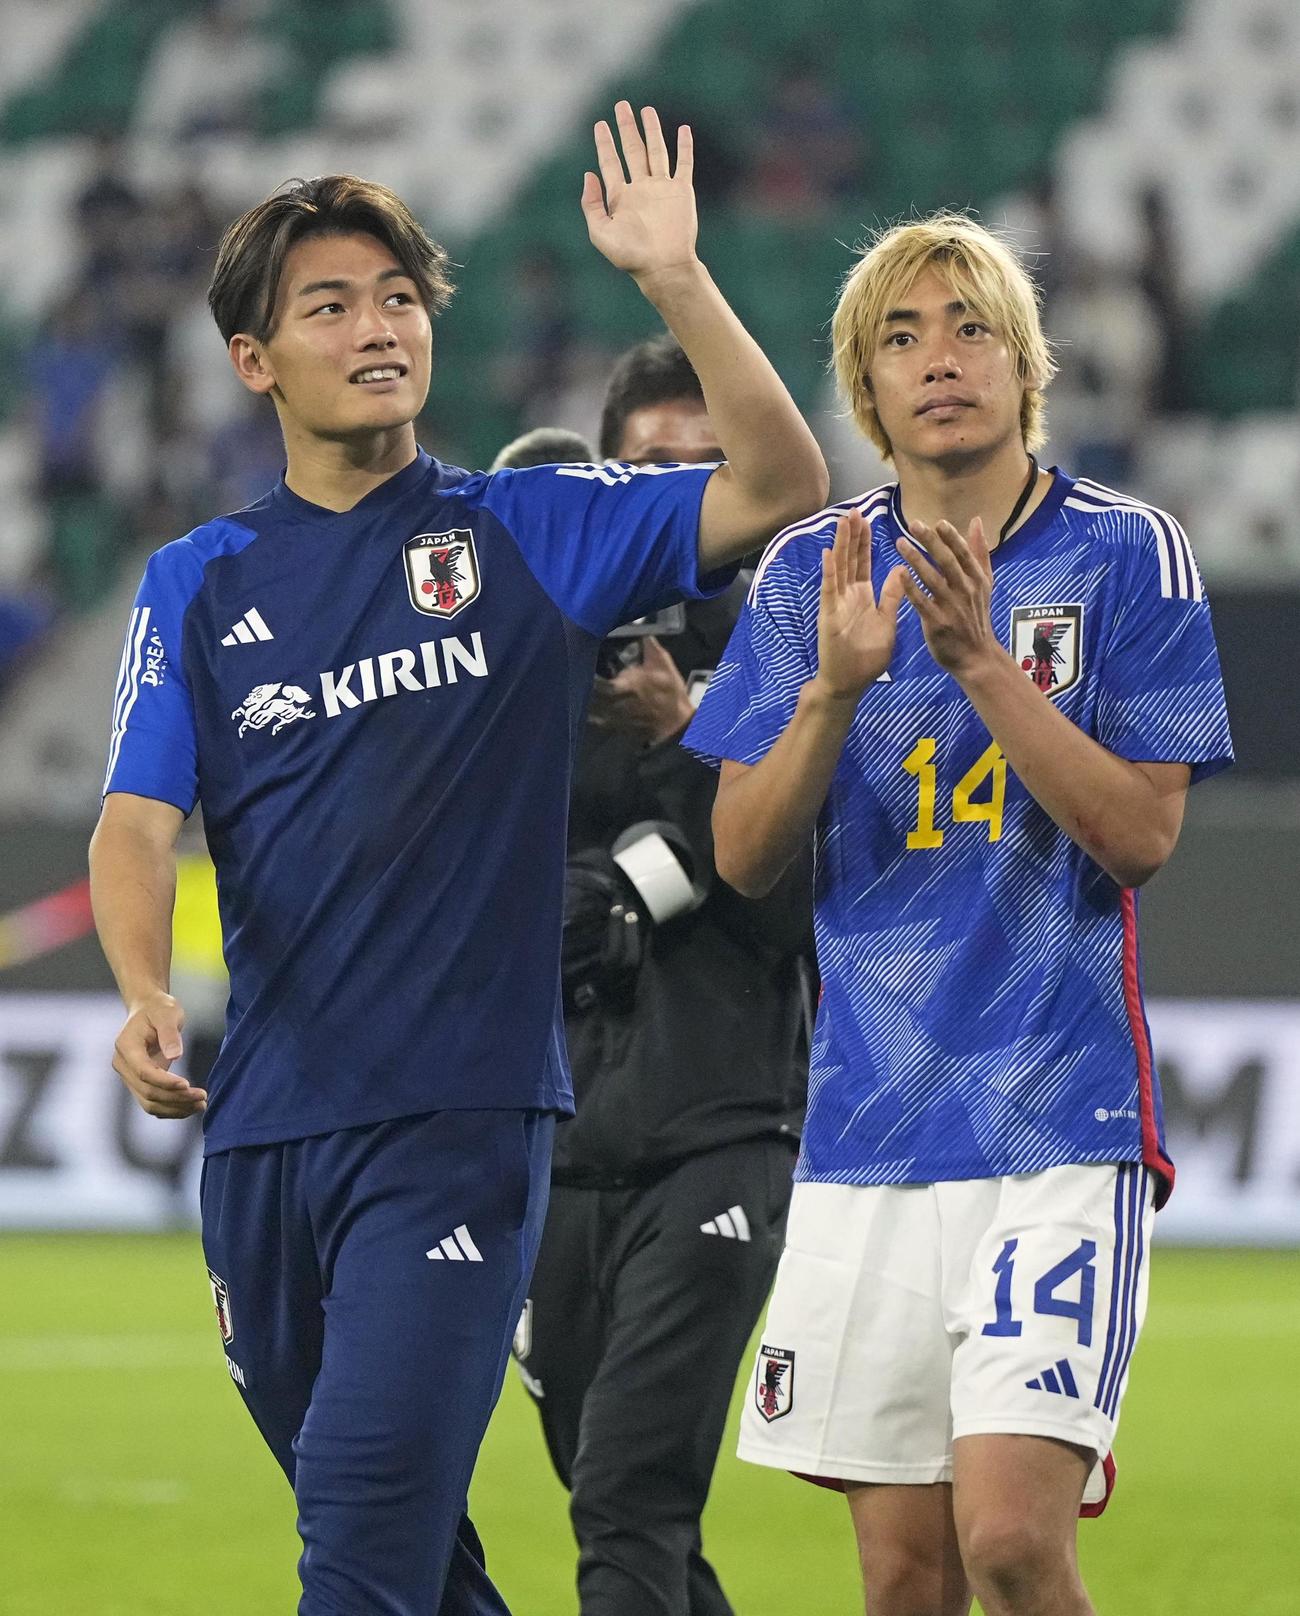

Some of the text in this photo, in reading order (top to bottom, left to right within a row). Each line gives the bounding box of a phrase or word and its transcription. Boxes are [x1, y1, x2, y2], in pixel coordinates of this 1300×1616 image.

[420, 532, 456, 546] JAPAN
[1027, 607, 1064, 618] JAPAN
[140, 626, 165, 687] DREA
[319, 631, 489, 719] KIRIN
[901, 737, 1007, 850] 14
[981, 1238, 1097, 1349] 14
[763, 1346, 785, 1358] JAPAN
